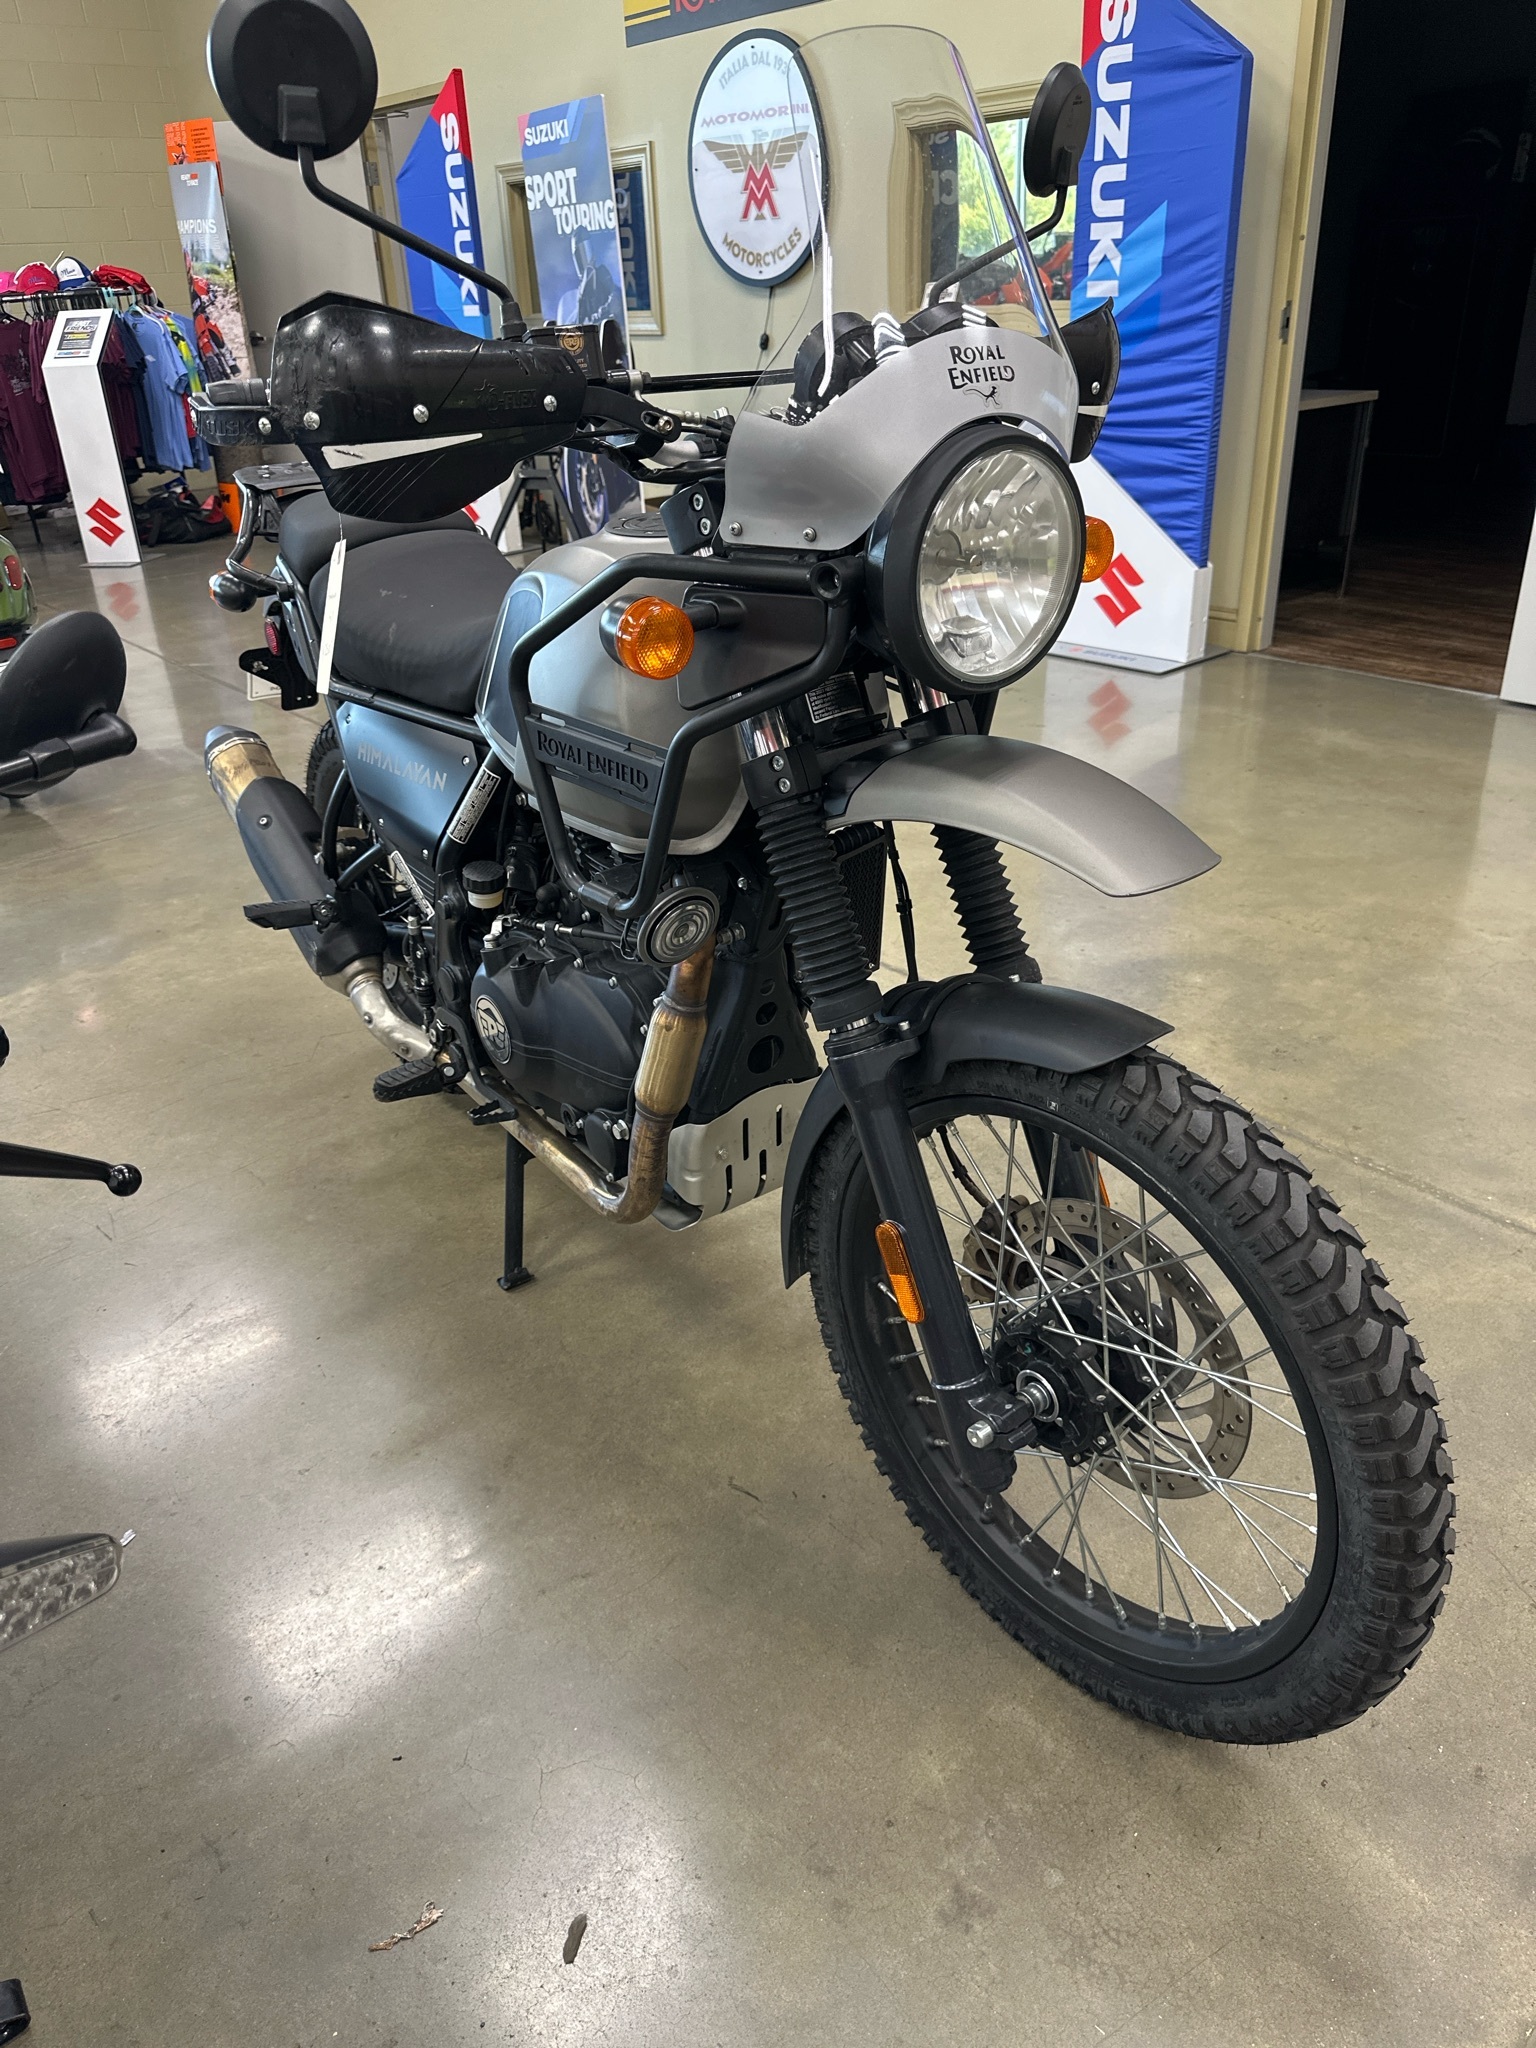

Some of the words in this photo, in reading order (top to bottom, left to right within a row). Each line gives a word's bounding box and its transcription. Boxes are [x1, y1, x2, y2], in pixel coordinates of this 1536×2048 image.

[718, 58, 750, 90] ITALIA
[751, 51, 772, 71] DAL
[523, 118, 570, 147] SUZUKI
[1085, 0, 1138, 298] SUZUKI
[524, 167, 578, 211] SPORT
[439, 112, 481, 317] SUZUKI
[552, 199, 617, 235] TOURING
[722, 227, 803, 269] MOTORCYCLES
[949, 345, 1006, 365] ROYAL
[947, 365, 1016, 390] ENFIELD
[357, 741, 448, 793] HIMALAYAN
[537, 730, 584, 767] ROYAL
[586, 751, 649, 793] ENFIELD
